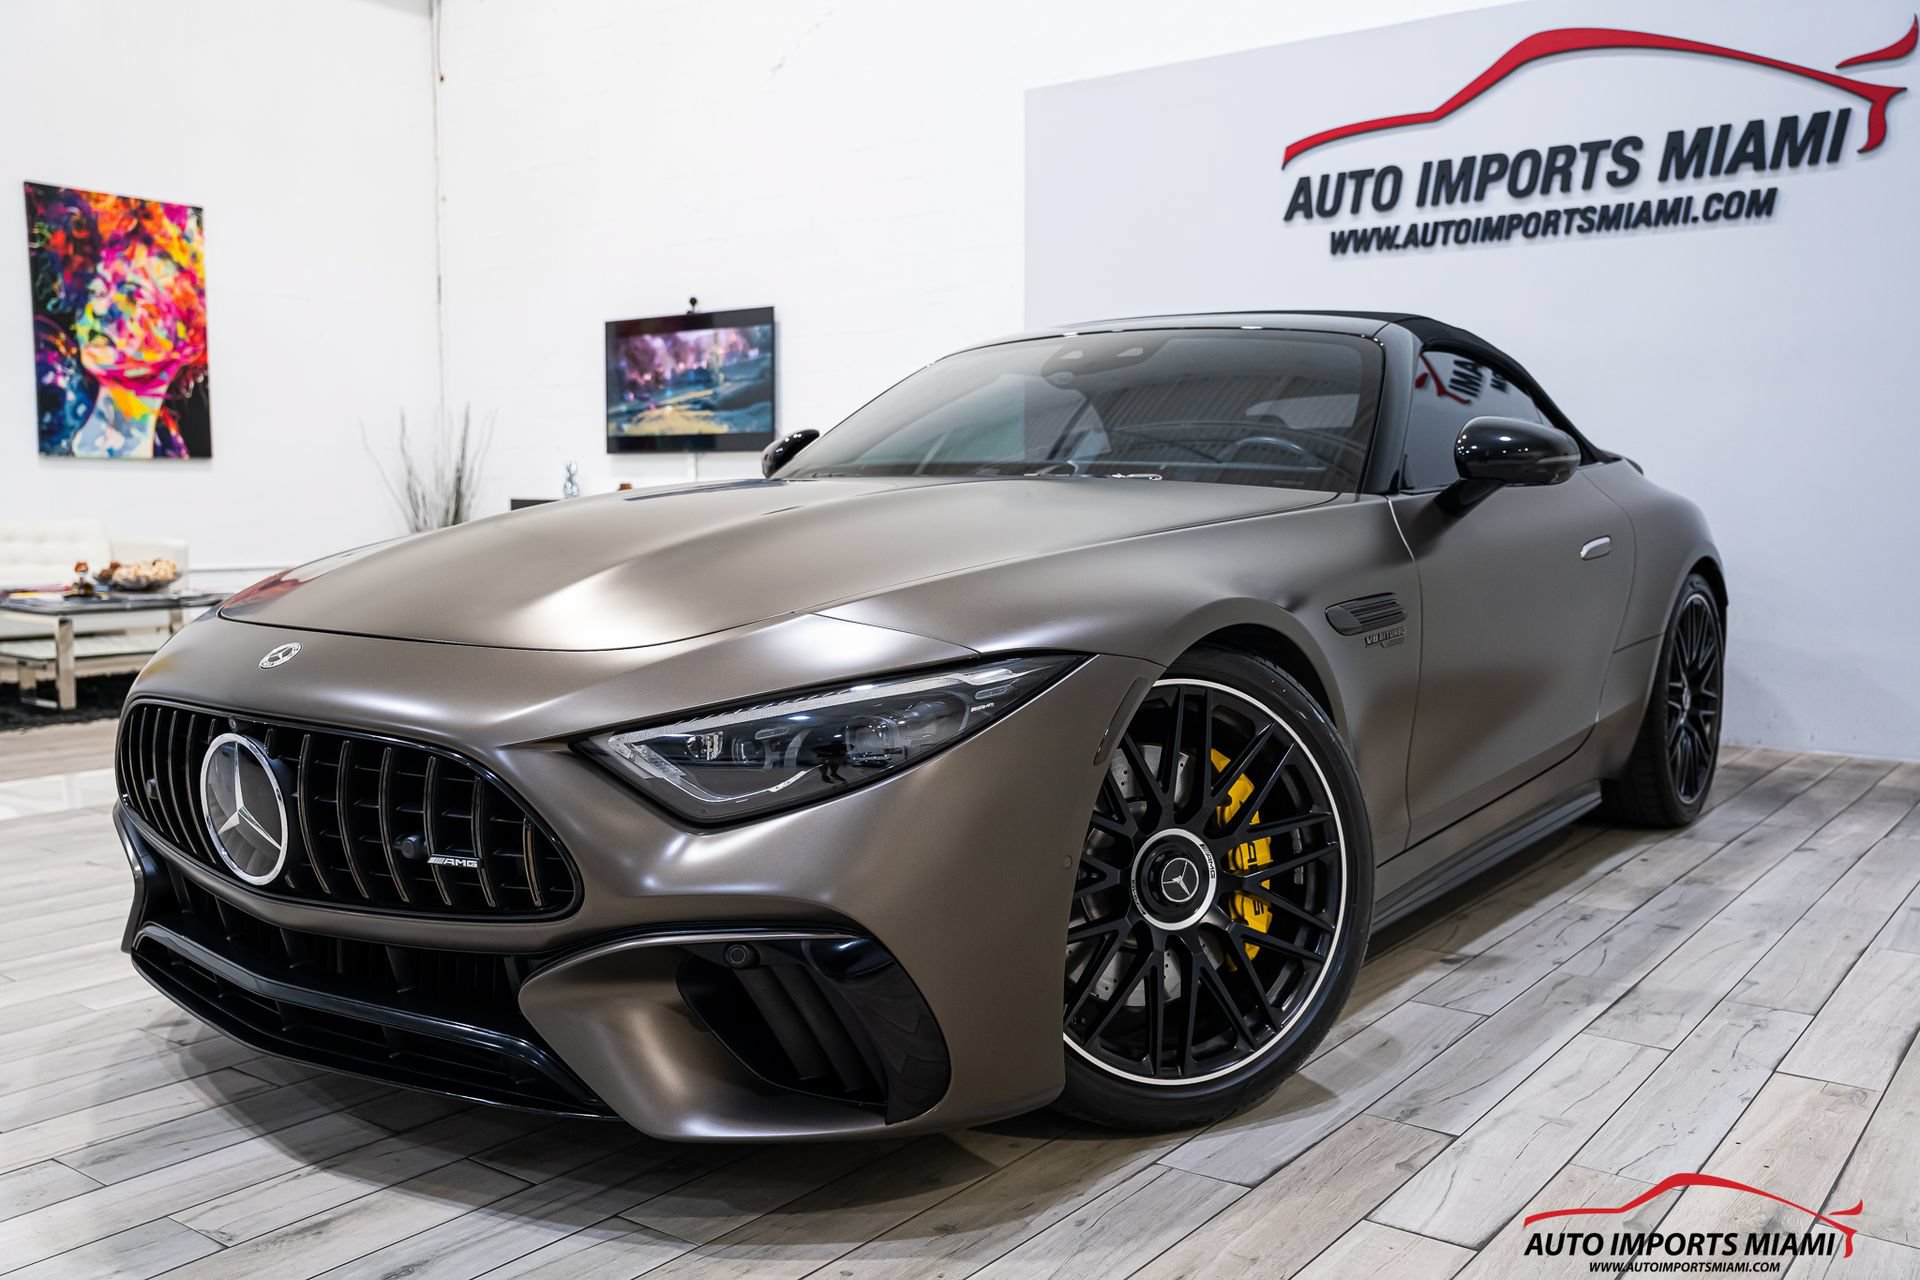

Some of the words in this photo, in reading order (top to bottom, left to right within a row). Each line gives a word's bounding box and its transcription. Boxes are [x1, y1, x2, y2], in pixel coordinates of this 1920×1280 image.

[1283, 166, 1402, 222] AUTO
[1415, 136, 1644, 208] IMPORTS
[1658, 107, 1852, 182] MIAMI
[1330, 187, 1778, 256] WWW.AUTOIMPORTSMIAMI.COM
[443, 857, 477, 868] AMG
